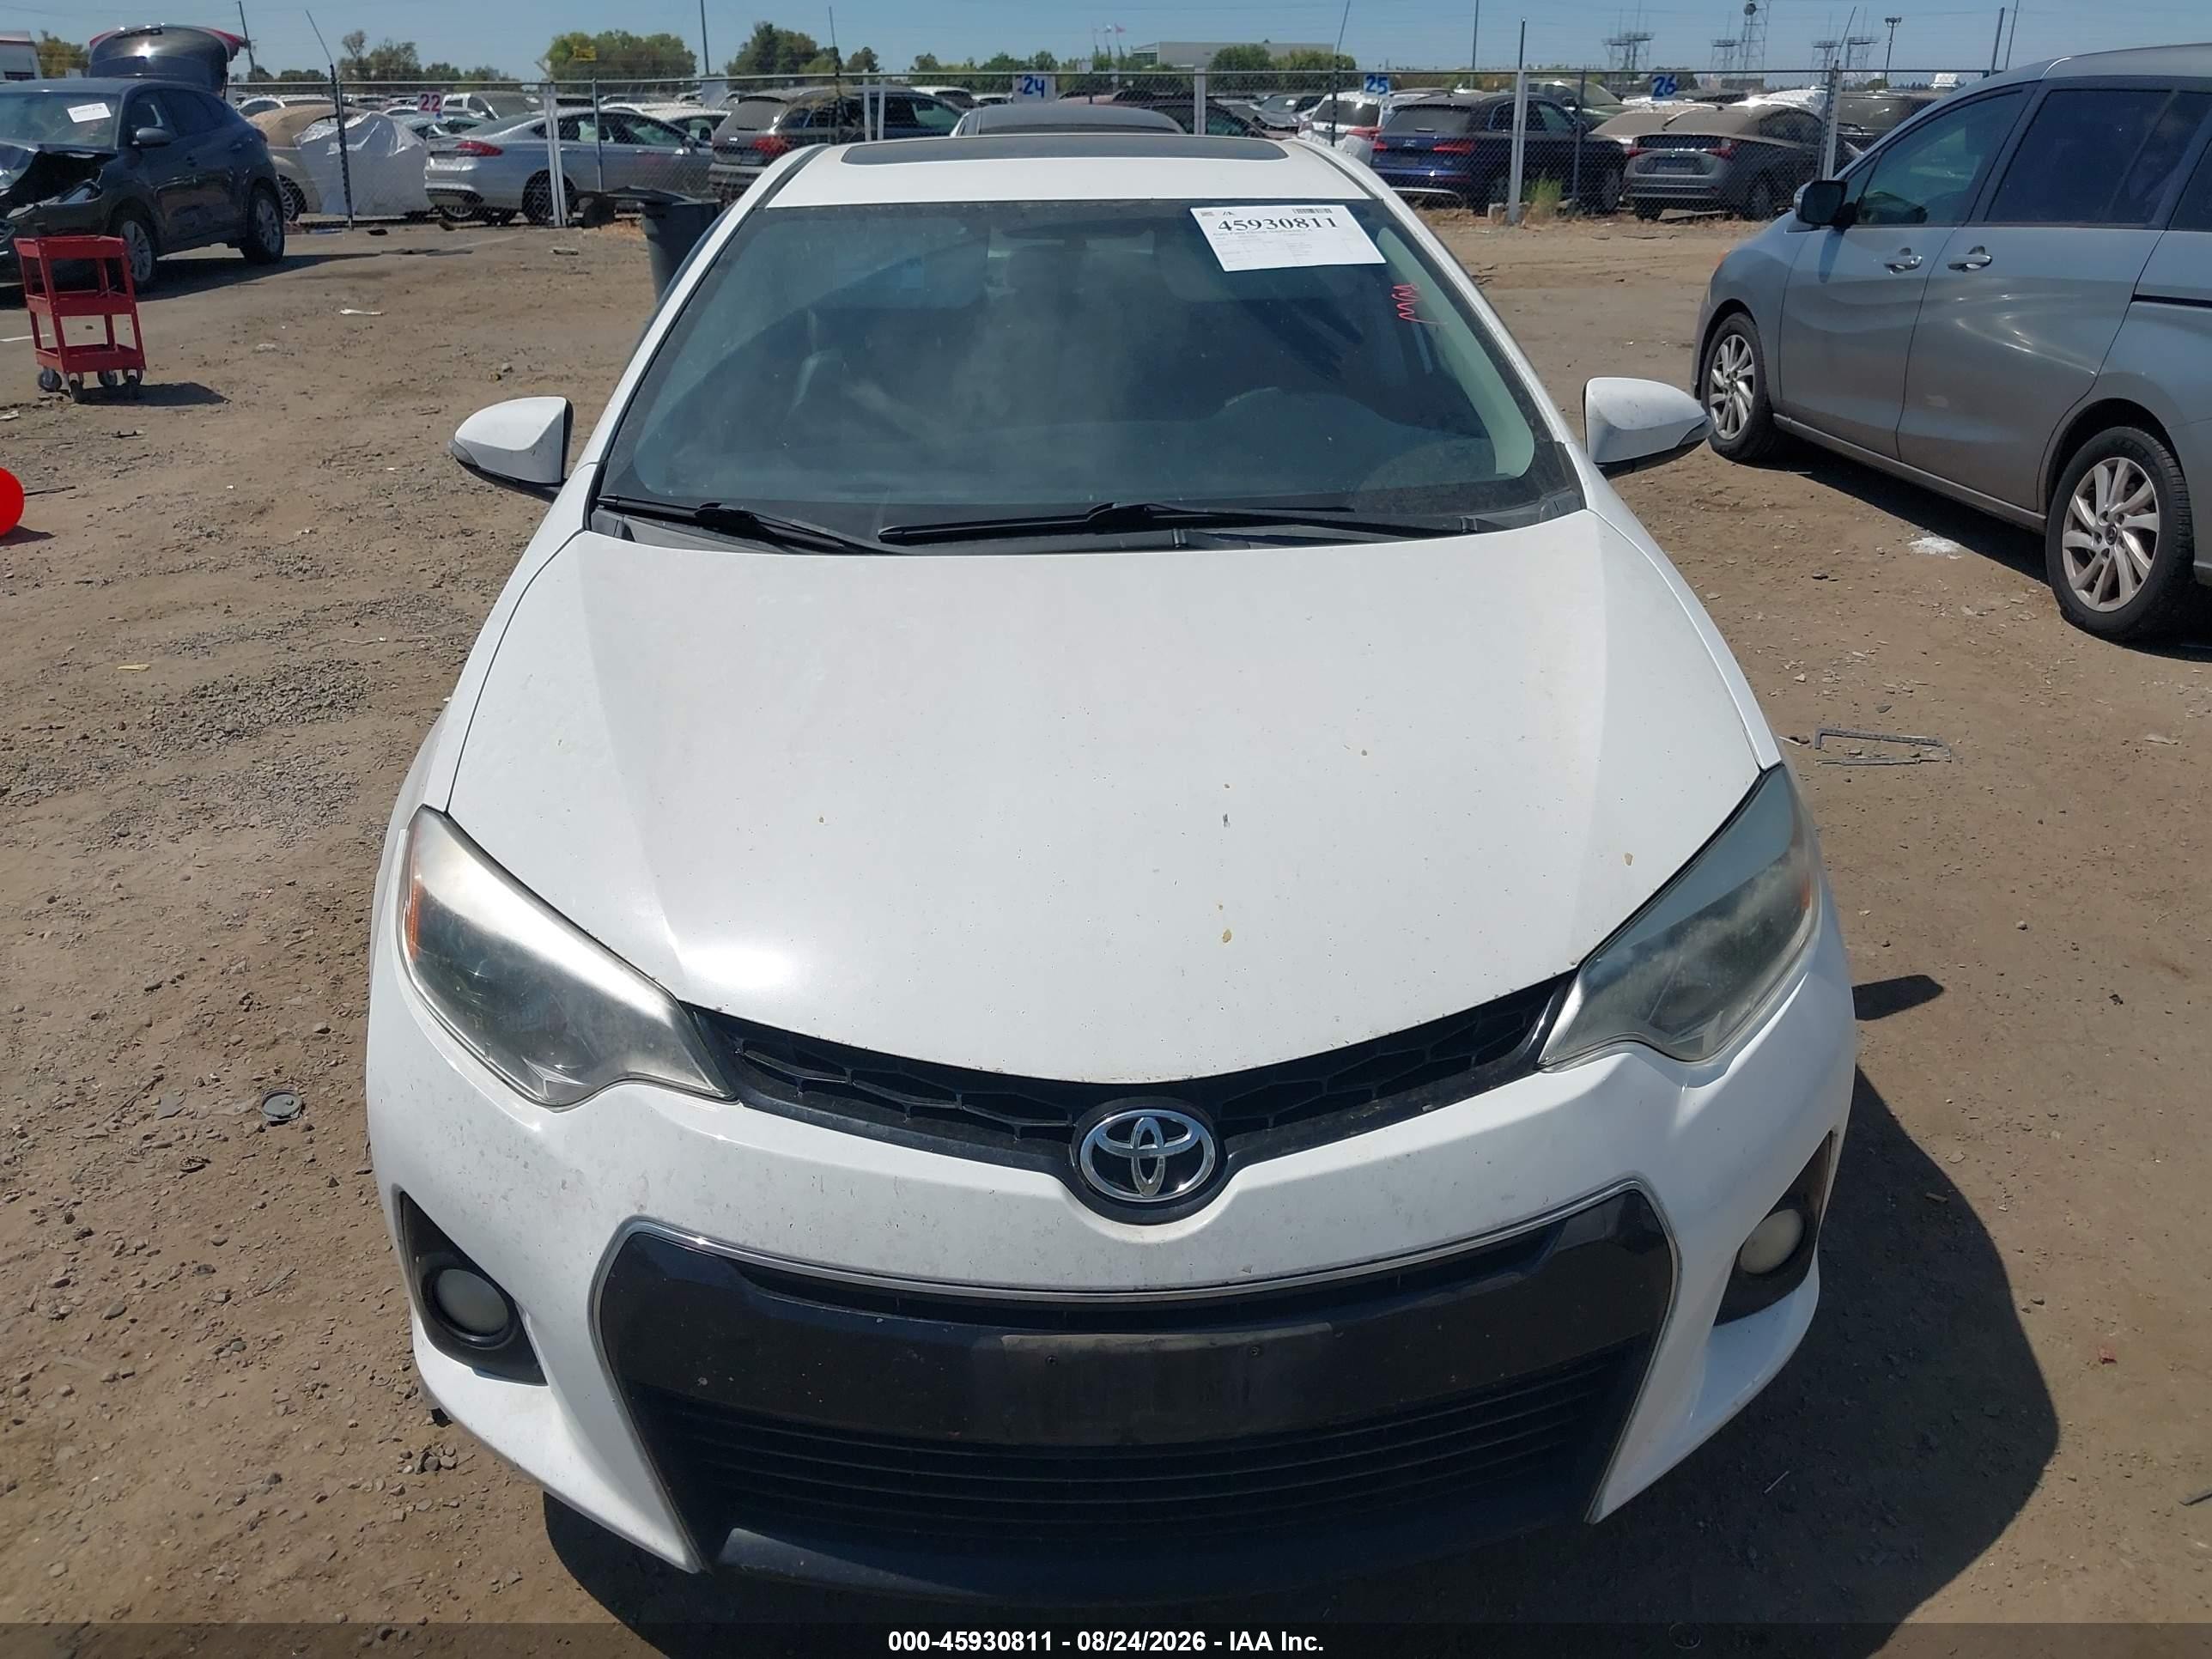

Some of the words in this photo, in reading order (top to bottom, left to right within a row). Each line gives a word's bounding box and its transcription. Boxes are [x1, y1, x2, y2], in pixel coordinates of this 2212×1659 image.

[1023, 75, 1045, 98] 24
[1365, 75, 1388, 94] 25
[1652, 75, 1677, 97] 26
[420, 94, 441, 112] 22
[1218, 217, 1340, 232] 45930811
